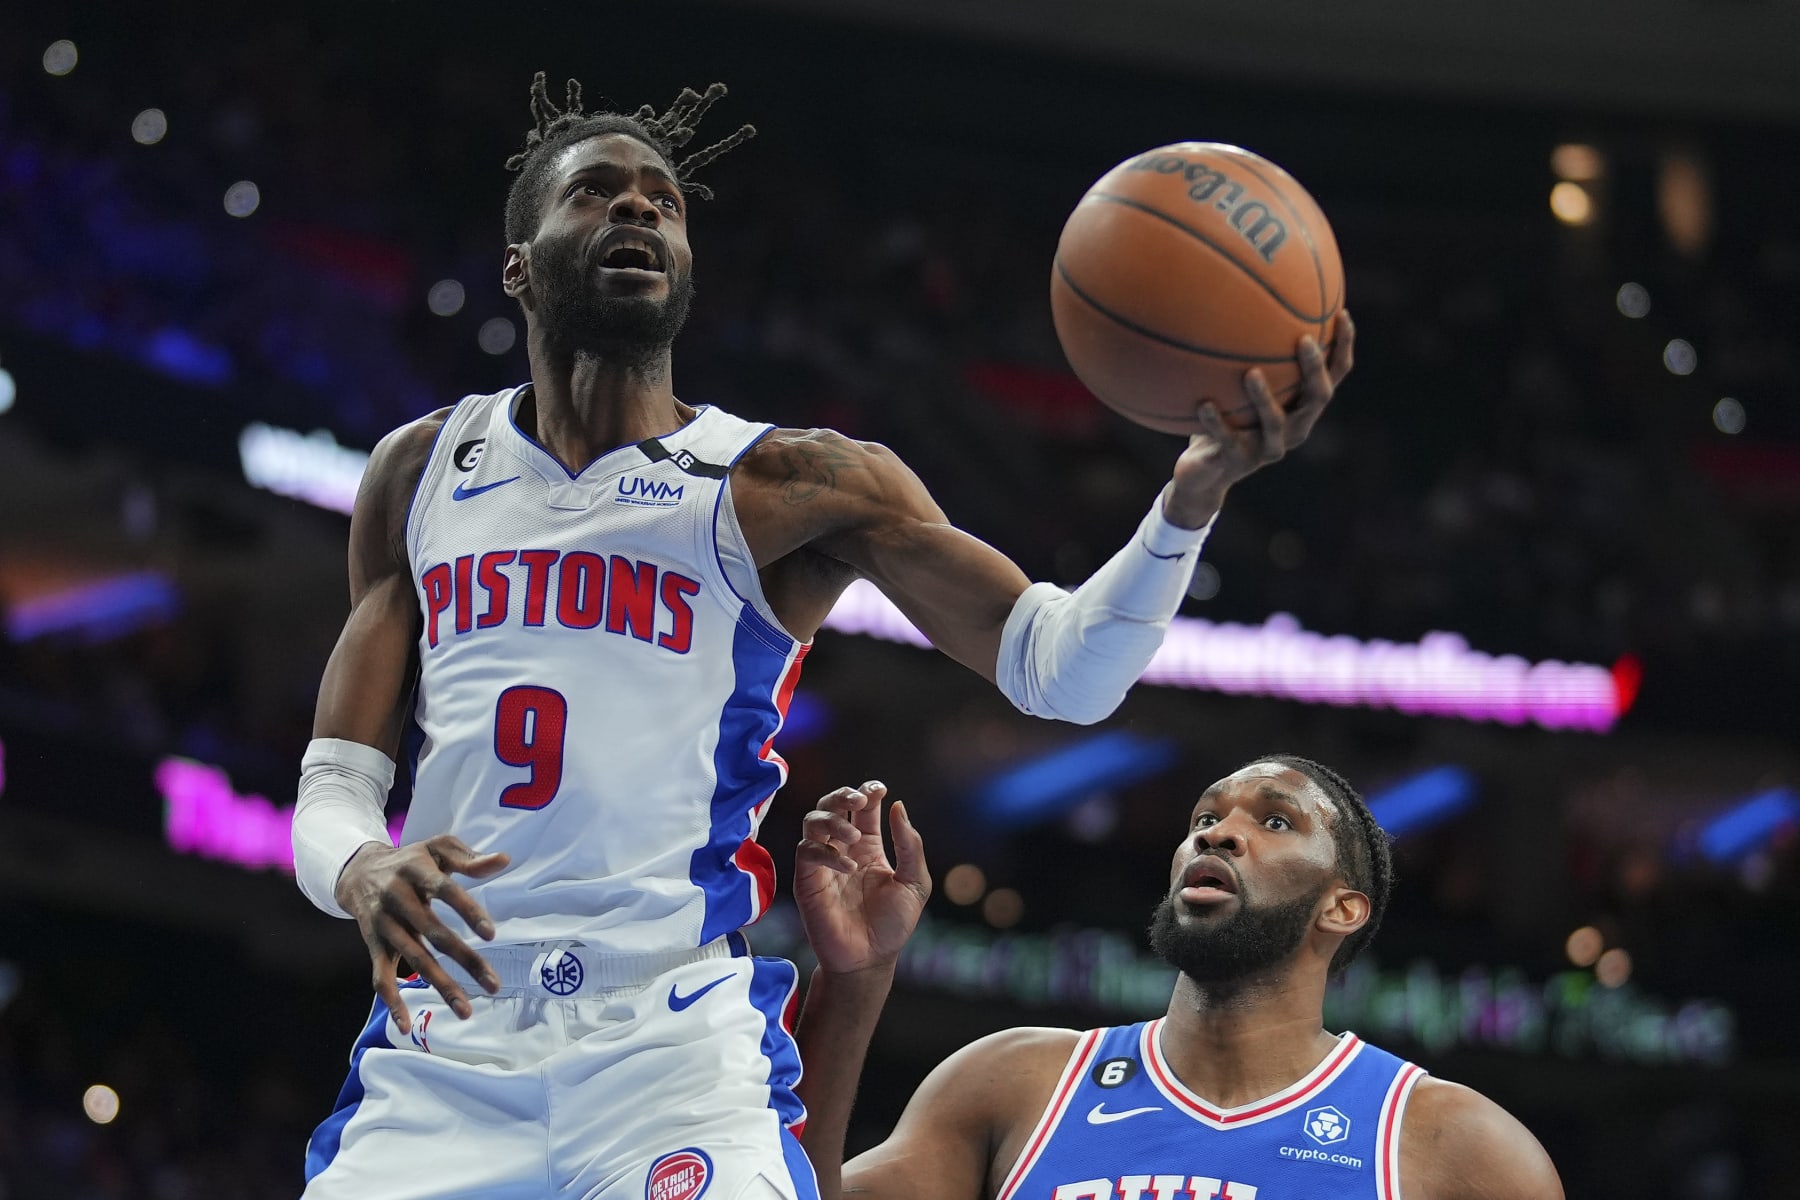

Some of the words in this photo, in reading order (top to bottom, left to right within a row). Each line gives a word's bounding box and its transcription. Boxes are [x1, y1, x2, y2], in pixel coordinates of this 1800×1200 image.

[461, 442, 486, 468] 6
[670, 450, 695, 470] 16
[618, 476, 684, 500] UWM
[422, 549, 700, 654] PISTONS
[494, 685, 568, 811] 9
[1100, 1061, 1128, 1085] 6
[1279, 1146, 1362, 1168] crypto.com
[652, 1164, 696, 1198] DETROIT
